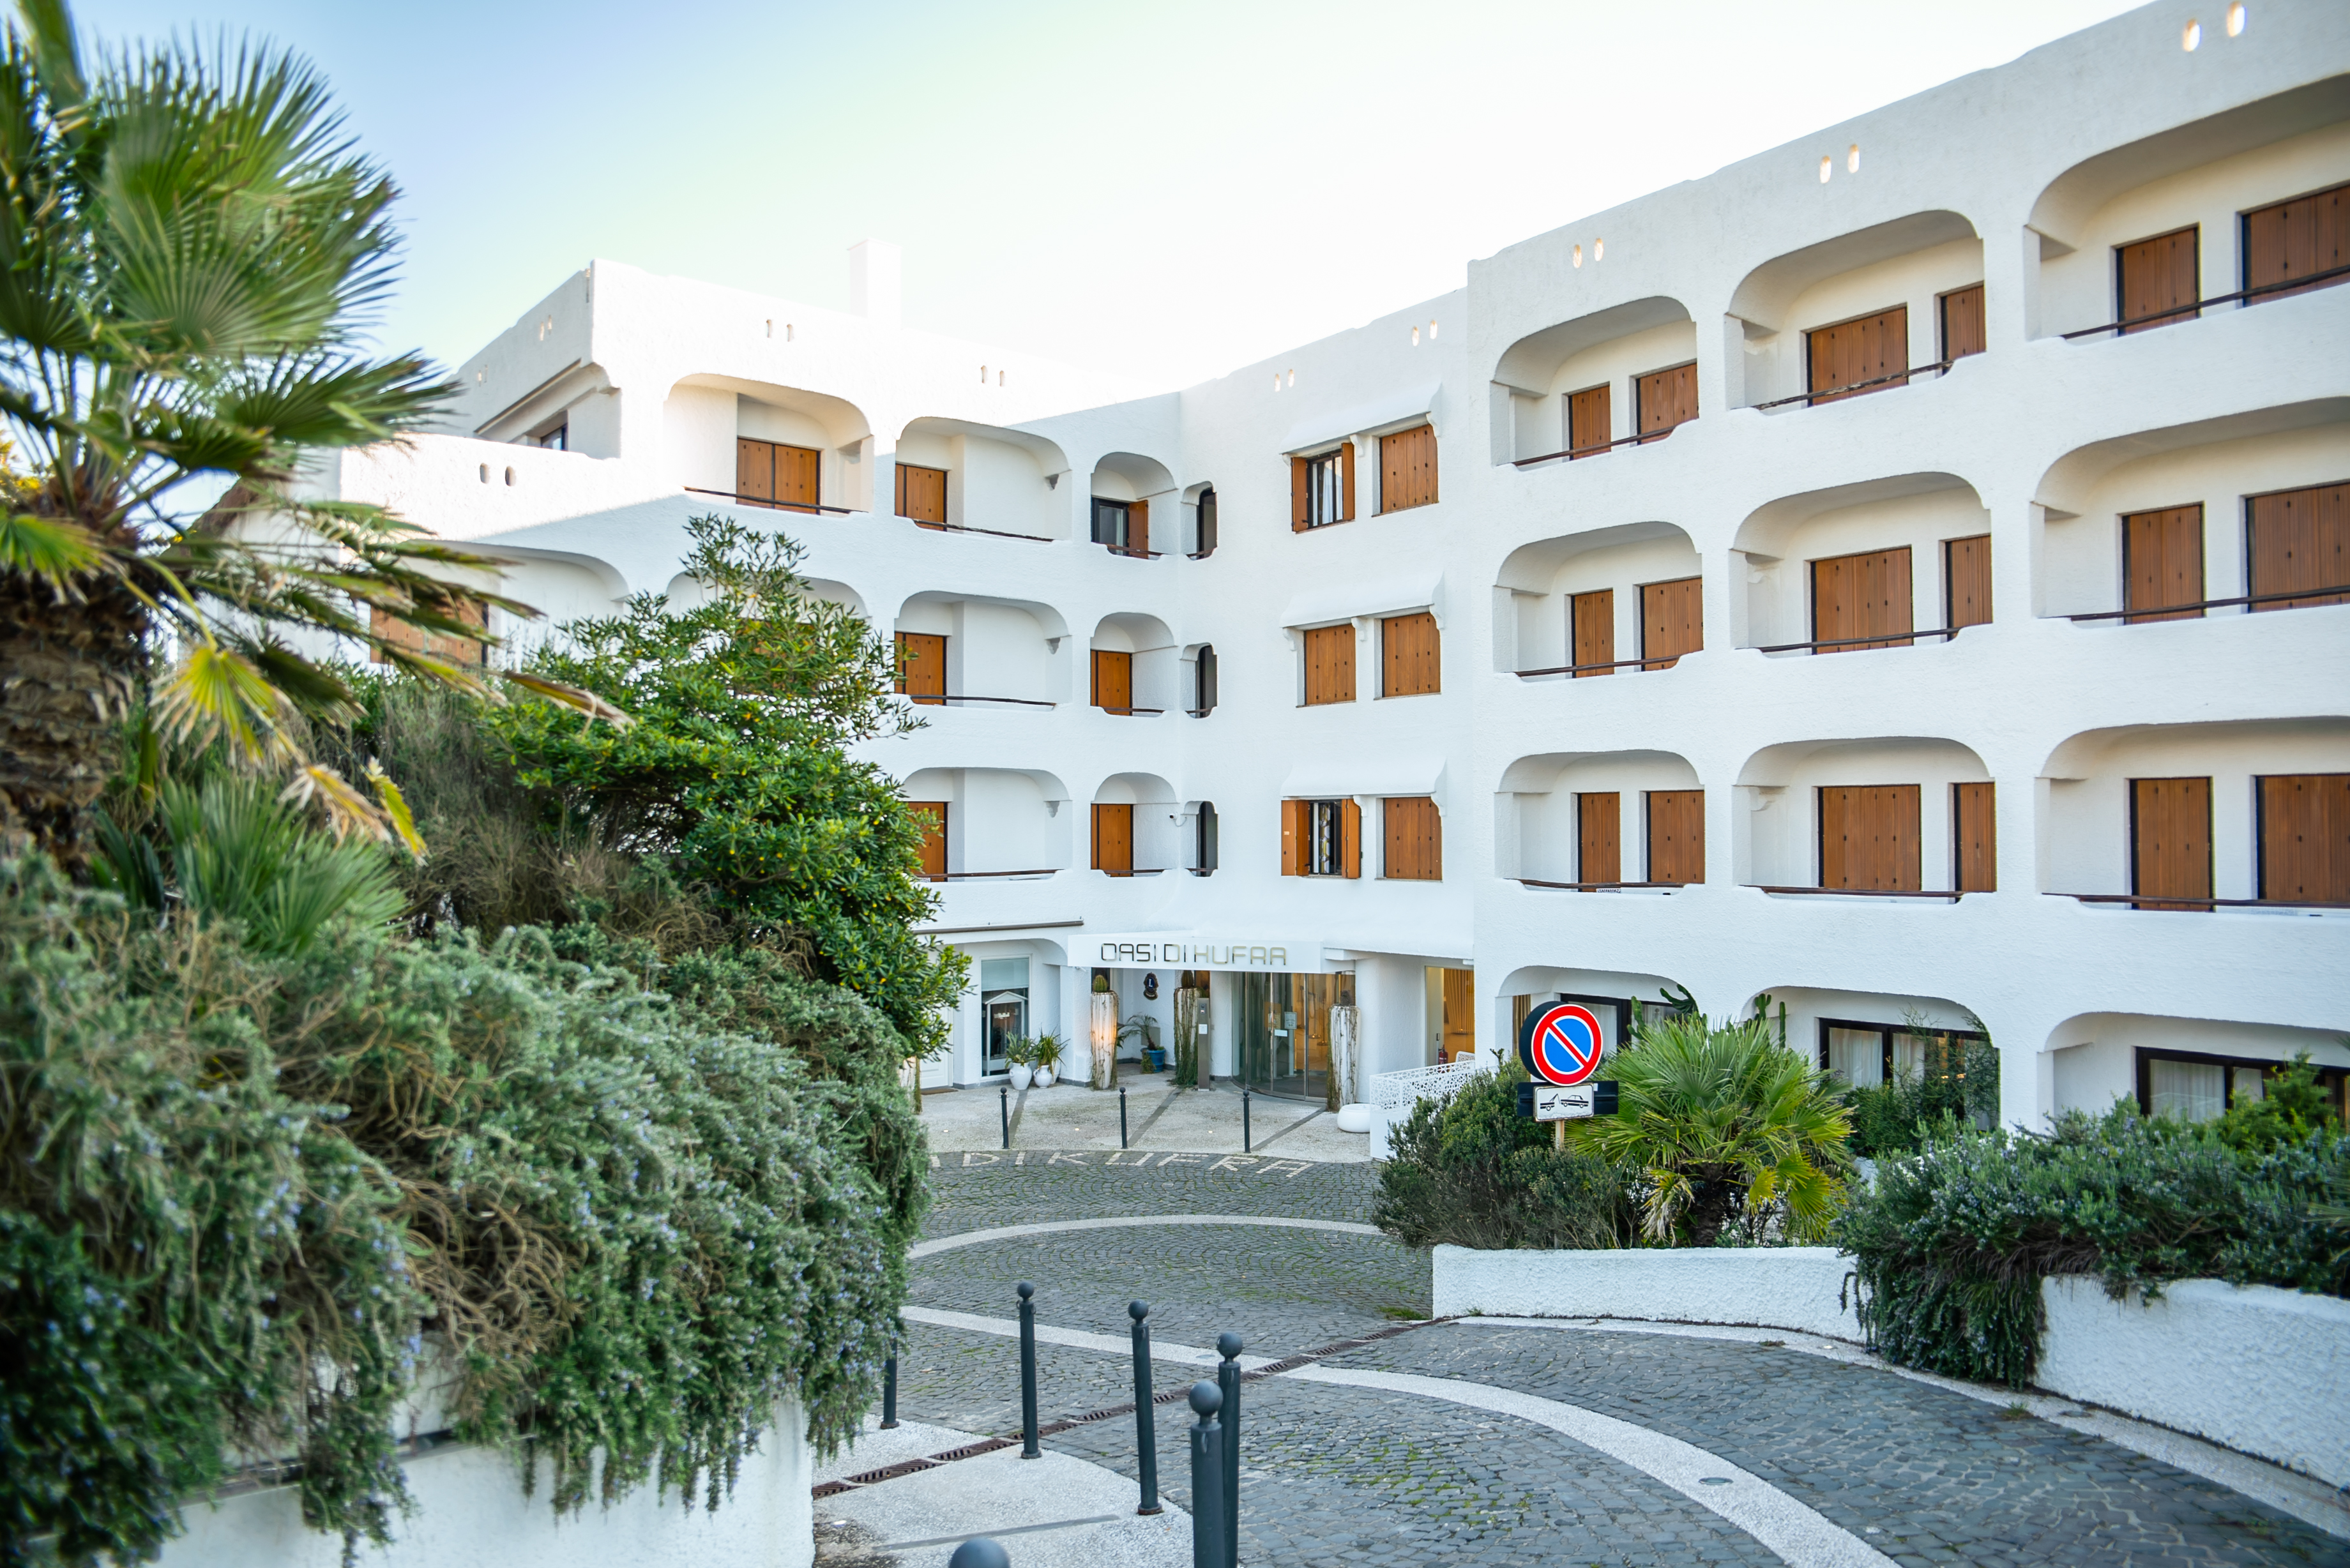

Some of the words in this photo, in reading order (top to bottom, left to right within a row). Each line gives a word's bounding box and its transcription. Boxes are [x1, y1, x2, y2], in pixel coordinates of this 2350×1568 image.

[1101, 943, 1156, 962] OASI
[1164, 944, 1186, 963] DI
[1047, 1151, 1315, 1178] KUFRA
